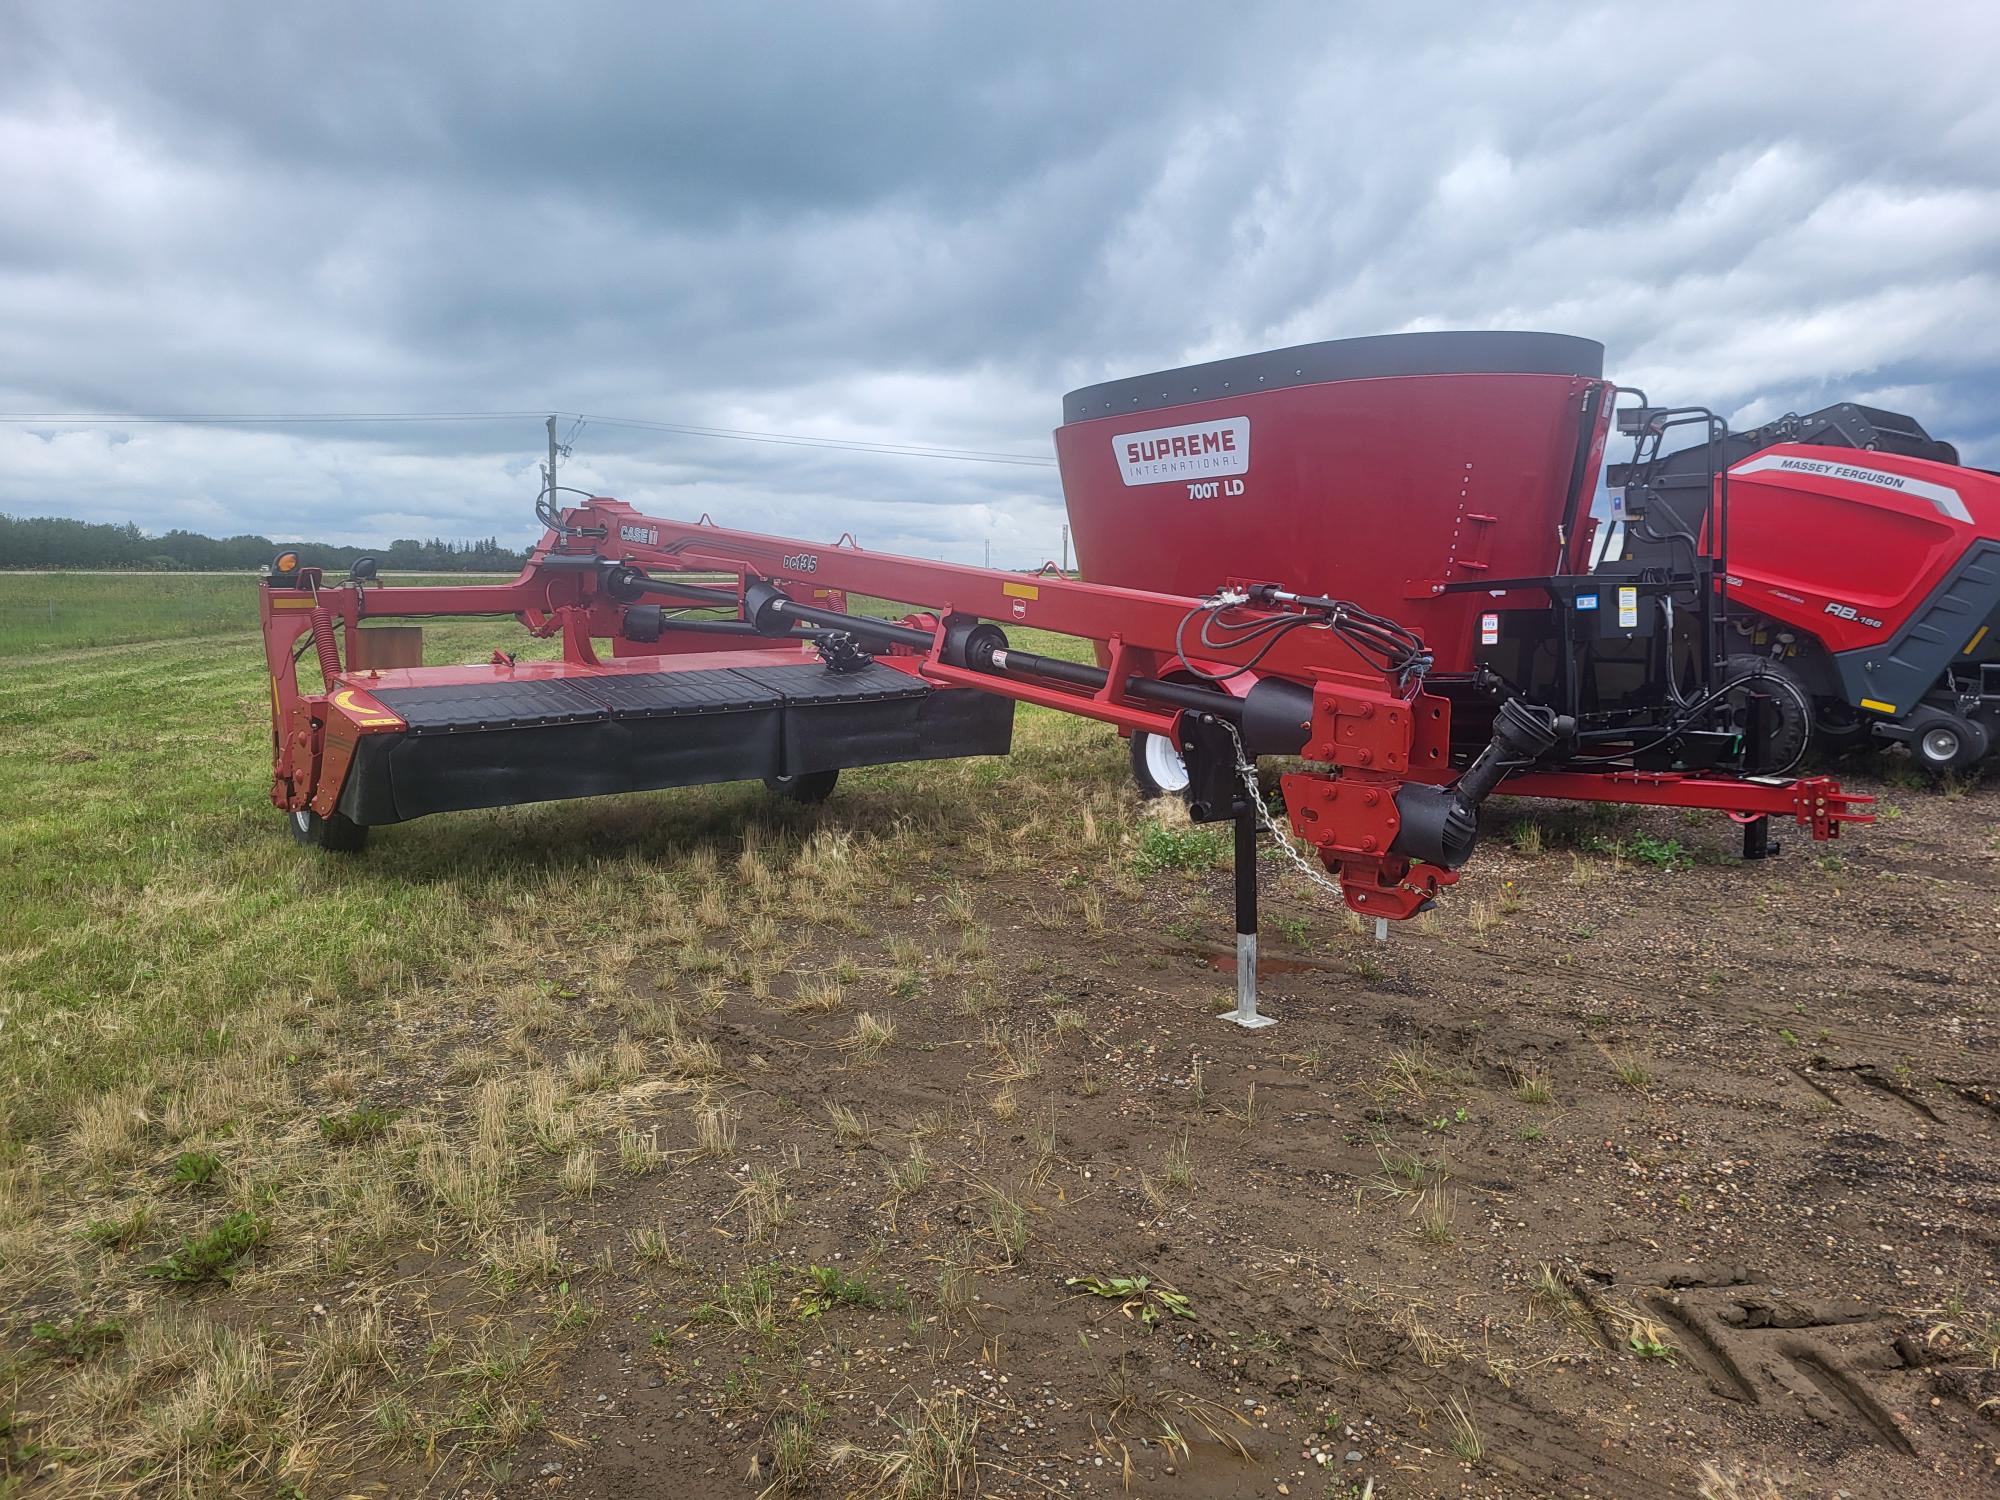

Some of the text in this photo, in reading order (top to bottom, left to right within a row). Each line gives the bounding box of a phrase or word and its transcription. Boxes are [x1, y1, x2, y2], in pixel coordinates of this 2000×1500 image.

[1127, 429, 1235, 463] SUPREME
[1130, 455, 1238, 477] INTERNATIONAL
[1781, 459, 1904, 488] MASSEY FERGUSON
[1186, 479, 1245, 500] 700T LD
[620, 525, 648, 544] CASE
[783, 553, 817, 573] DC135
